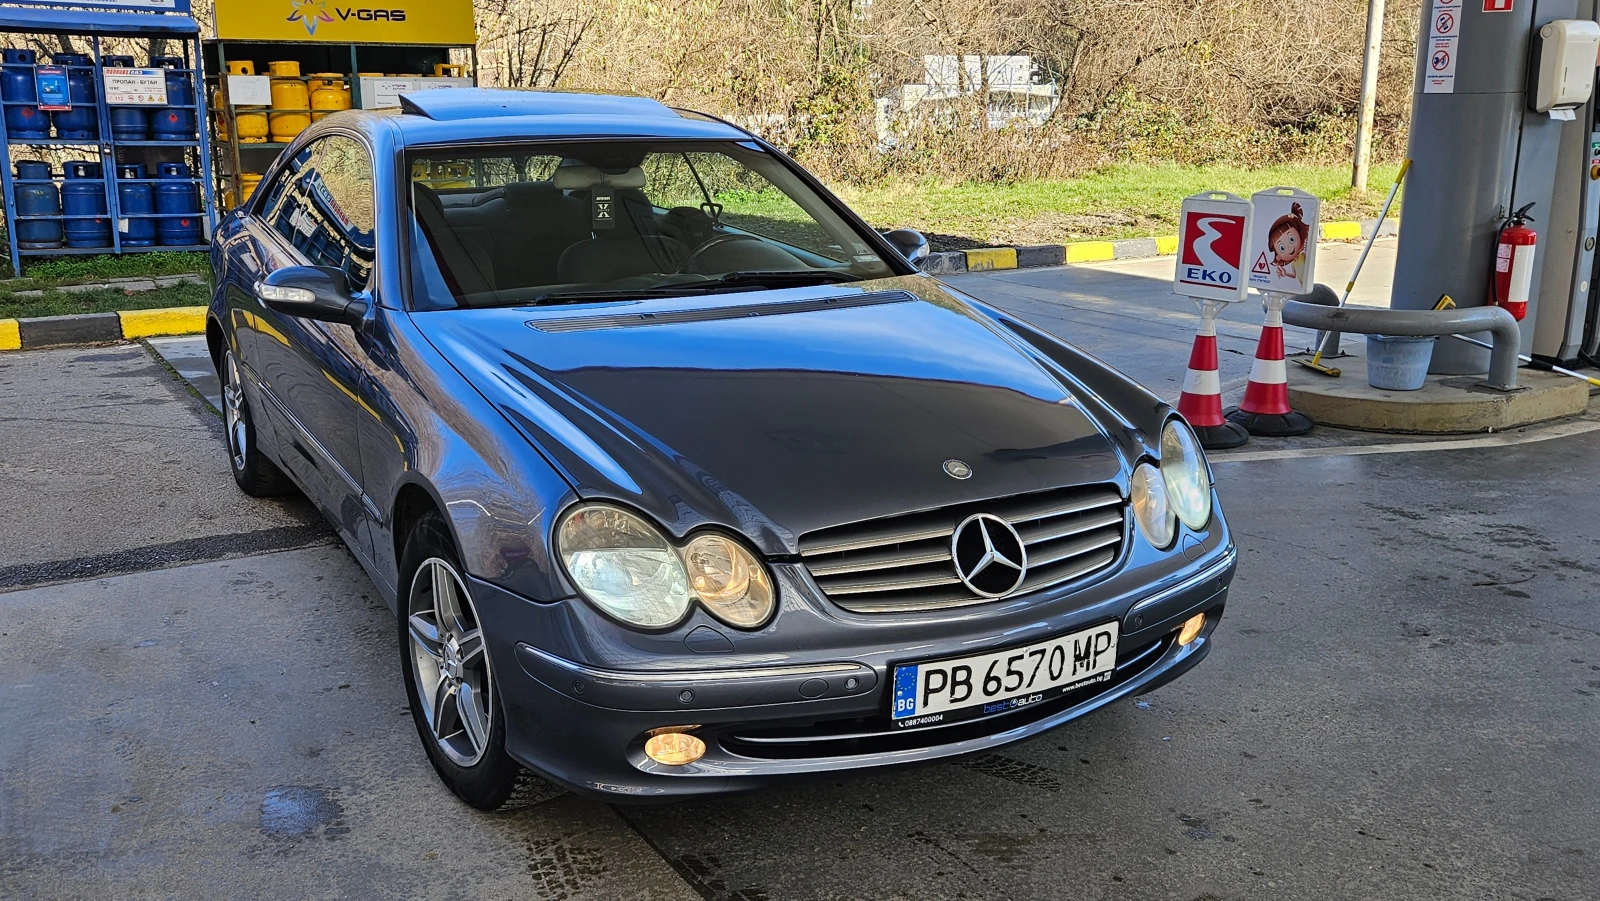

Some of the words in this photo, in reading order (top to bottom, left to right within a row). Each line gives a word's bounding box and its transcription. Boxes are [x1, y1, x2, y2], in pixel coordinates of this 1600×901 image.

[335, 7, 406, 21] V-GAS
[1187, 267, 1232, 284] EKO
[922, 664, 973, 709] PB
[982, 644, 1066, 697] 6570
[1071, 630, 1112, 677] MP
[1062, 675, 1104, 693] www.bestauto.bg
[897, 698, 914, 712] BG
